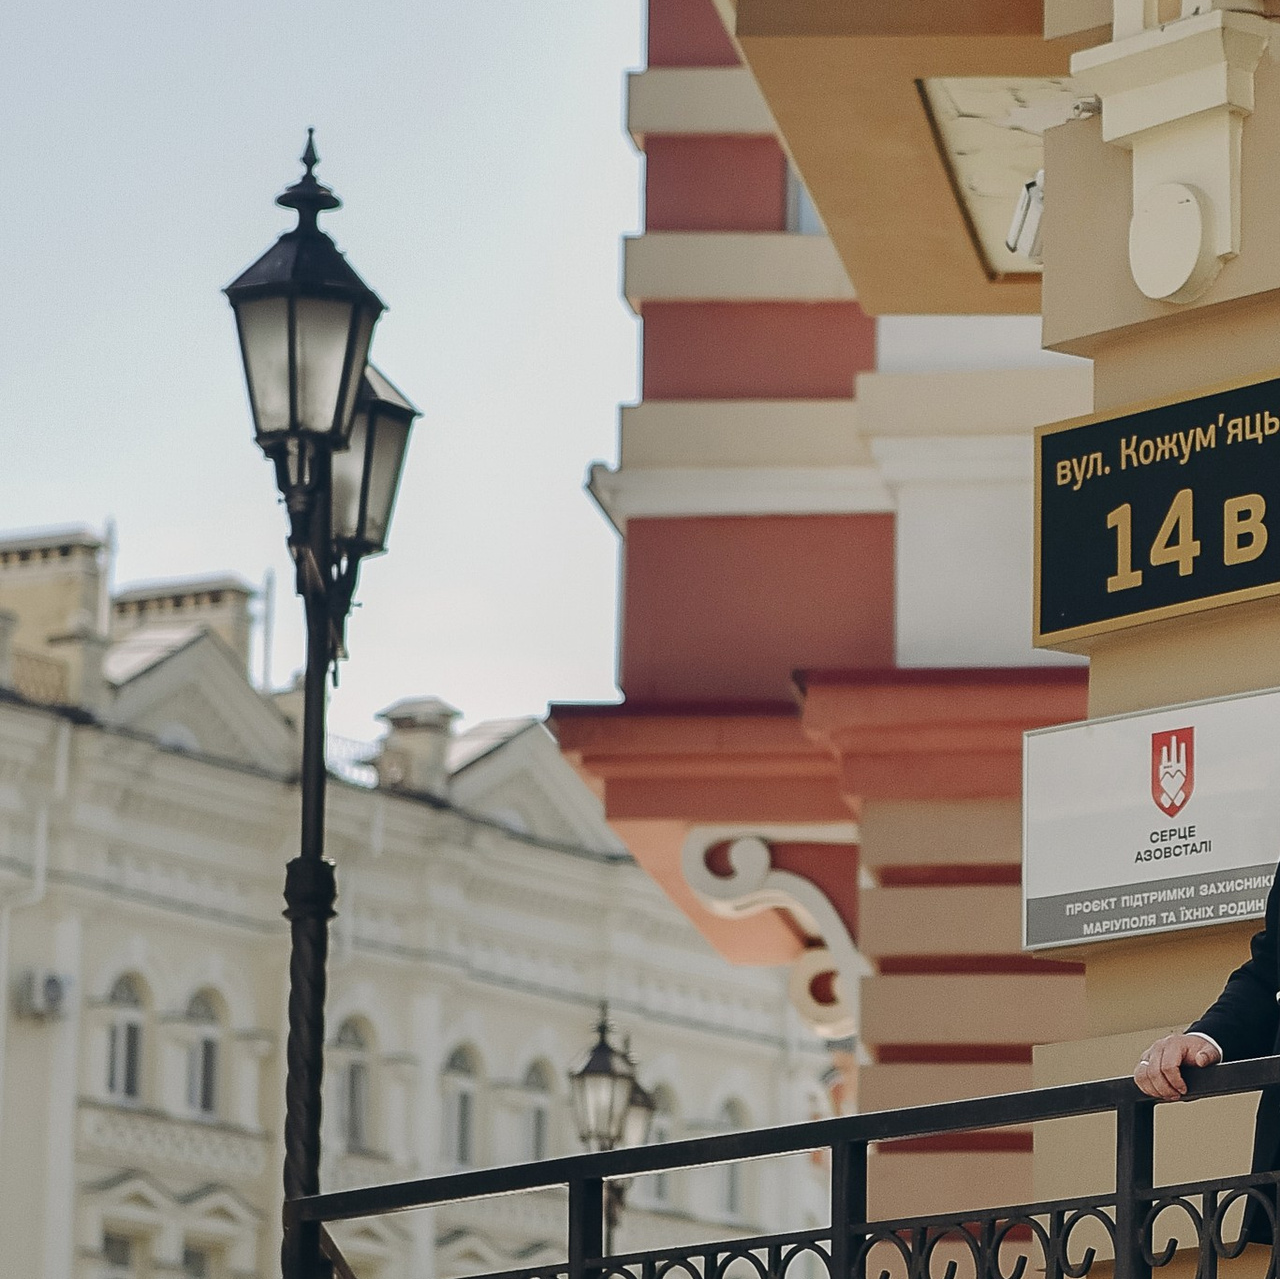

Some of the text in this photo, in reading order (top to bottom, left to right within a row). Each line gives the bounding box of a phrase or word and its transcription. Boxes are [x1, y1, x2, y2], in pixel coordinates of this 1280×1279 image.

[1056, 452, 1111, 491] вул.
[1106, 488, 1201, 593] 14
[1134, 840, 1212, 863] АЗОВСТАЛІ
[1149, 825, 1196, 843] СЕРЦЕ
[1065, 874, 1275, 916] ПРОЄКТ ПІДТРИМКИ ЗАХИСНИКІ
[1083, 898, 1265, 935] МАРІУПОЛЯ ТА ЇХНІХ РОДИН
